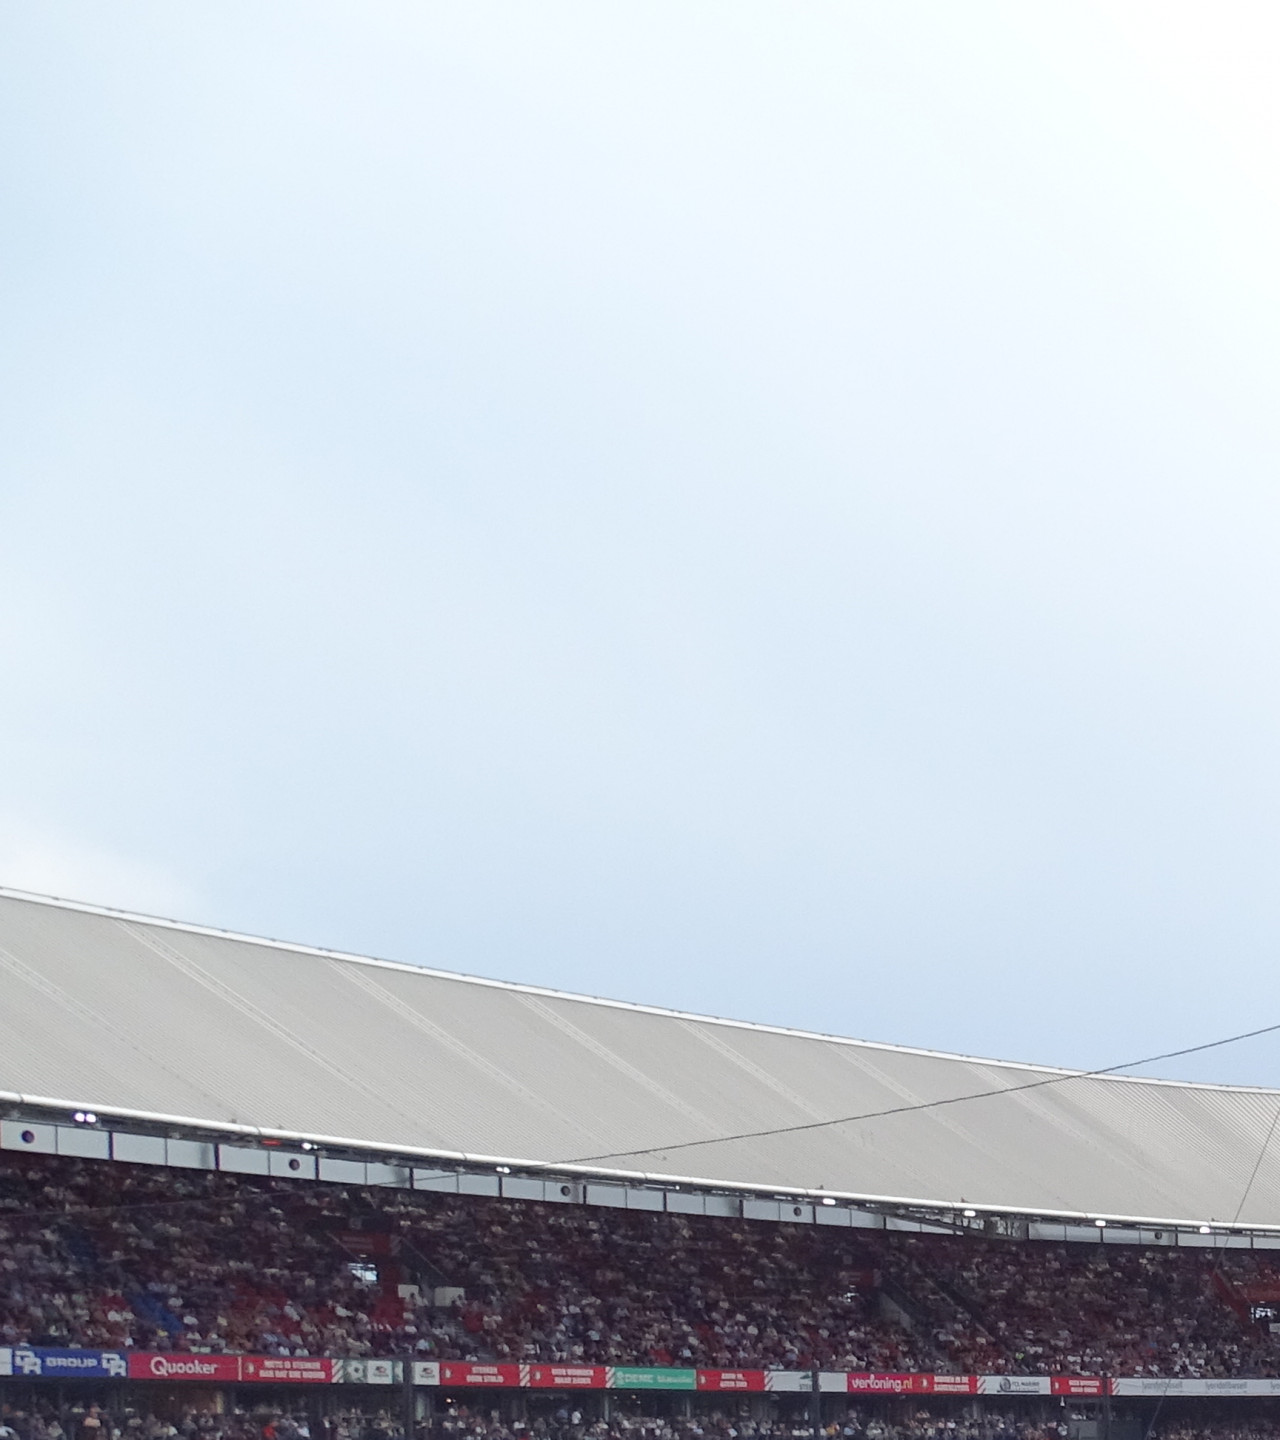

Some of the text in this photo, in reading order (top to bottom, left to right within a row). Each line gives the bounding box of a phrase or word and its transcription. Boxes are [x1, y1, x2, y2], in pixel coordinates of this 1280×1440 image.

[46, 1357, 98, 1368] GROUP
[150, 1356, 218, 1376] Quooker
[852, 1374, 912, 1391] verloning.nl
